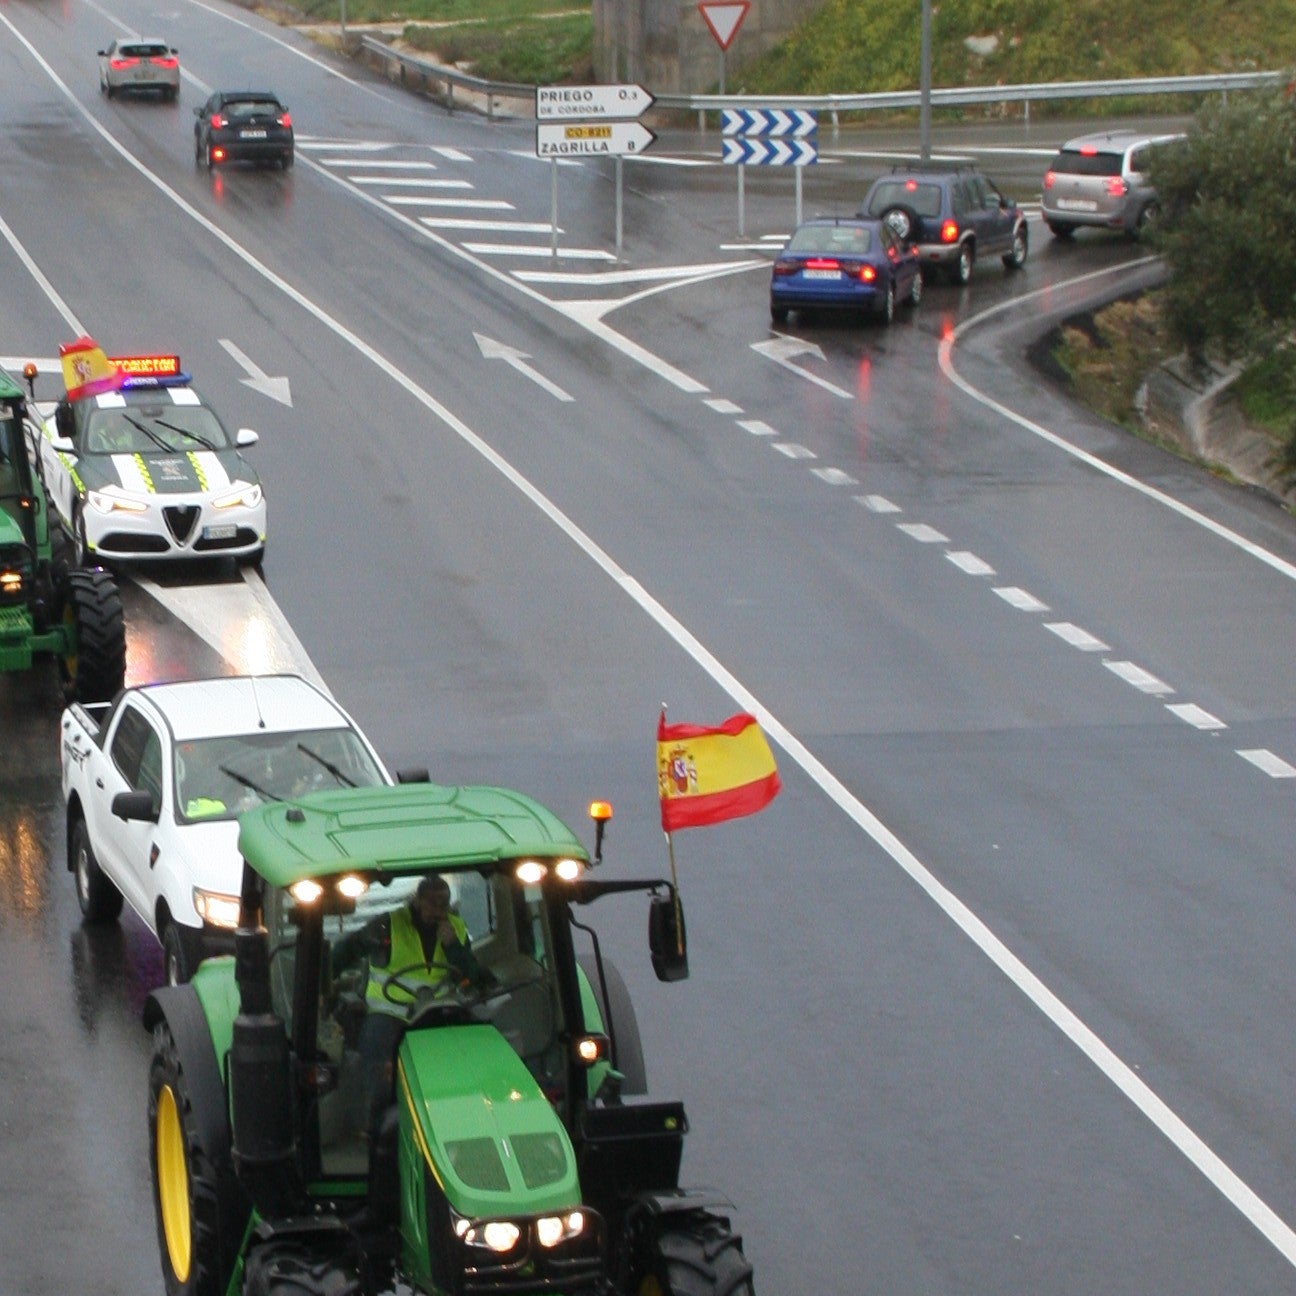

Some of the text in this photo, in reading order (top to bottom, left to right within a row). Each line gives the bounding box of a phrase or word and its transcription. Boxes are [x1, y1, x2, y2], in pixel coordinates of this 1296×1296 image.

[540, 90, 593, 102] PRIEGO
[540, 105, 552, 115] DE
[541, 142, 609, 154] ZAGRILLA
